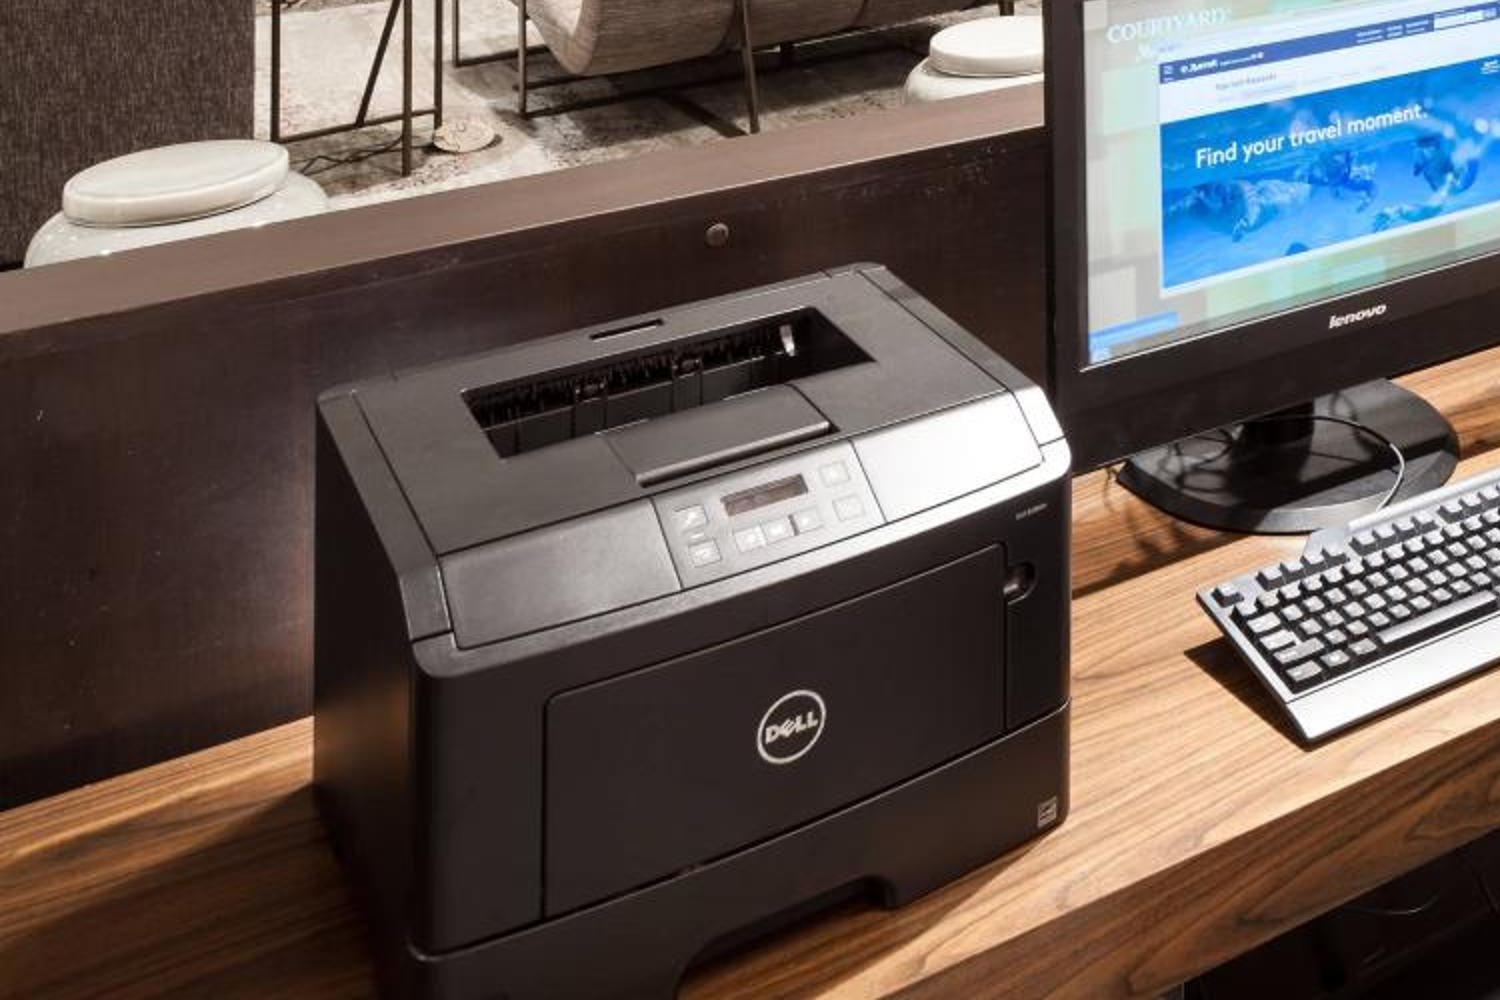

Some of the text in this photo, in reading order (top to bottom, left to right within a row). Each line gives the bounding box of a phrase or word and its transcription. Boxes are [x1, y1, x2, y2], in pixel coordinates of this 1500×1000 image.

[1106, 8, 1227, 44] COURTYARD
[1196, 103, 1428, 168] Find your travel moment.
[1329, 304, 1387, 329] lenovo
[765, 710, 819, 744] DELL
